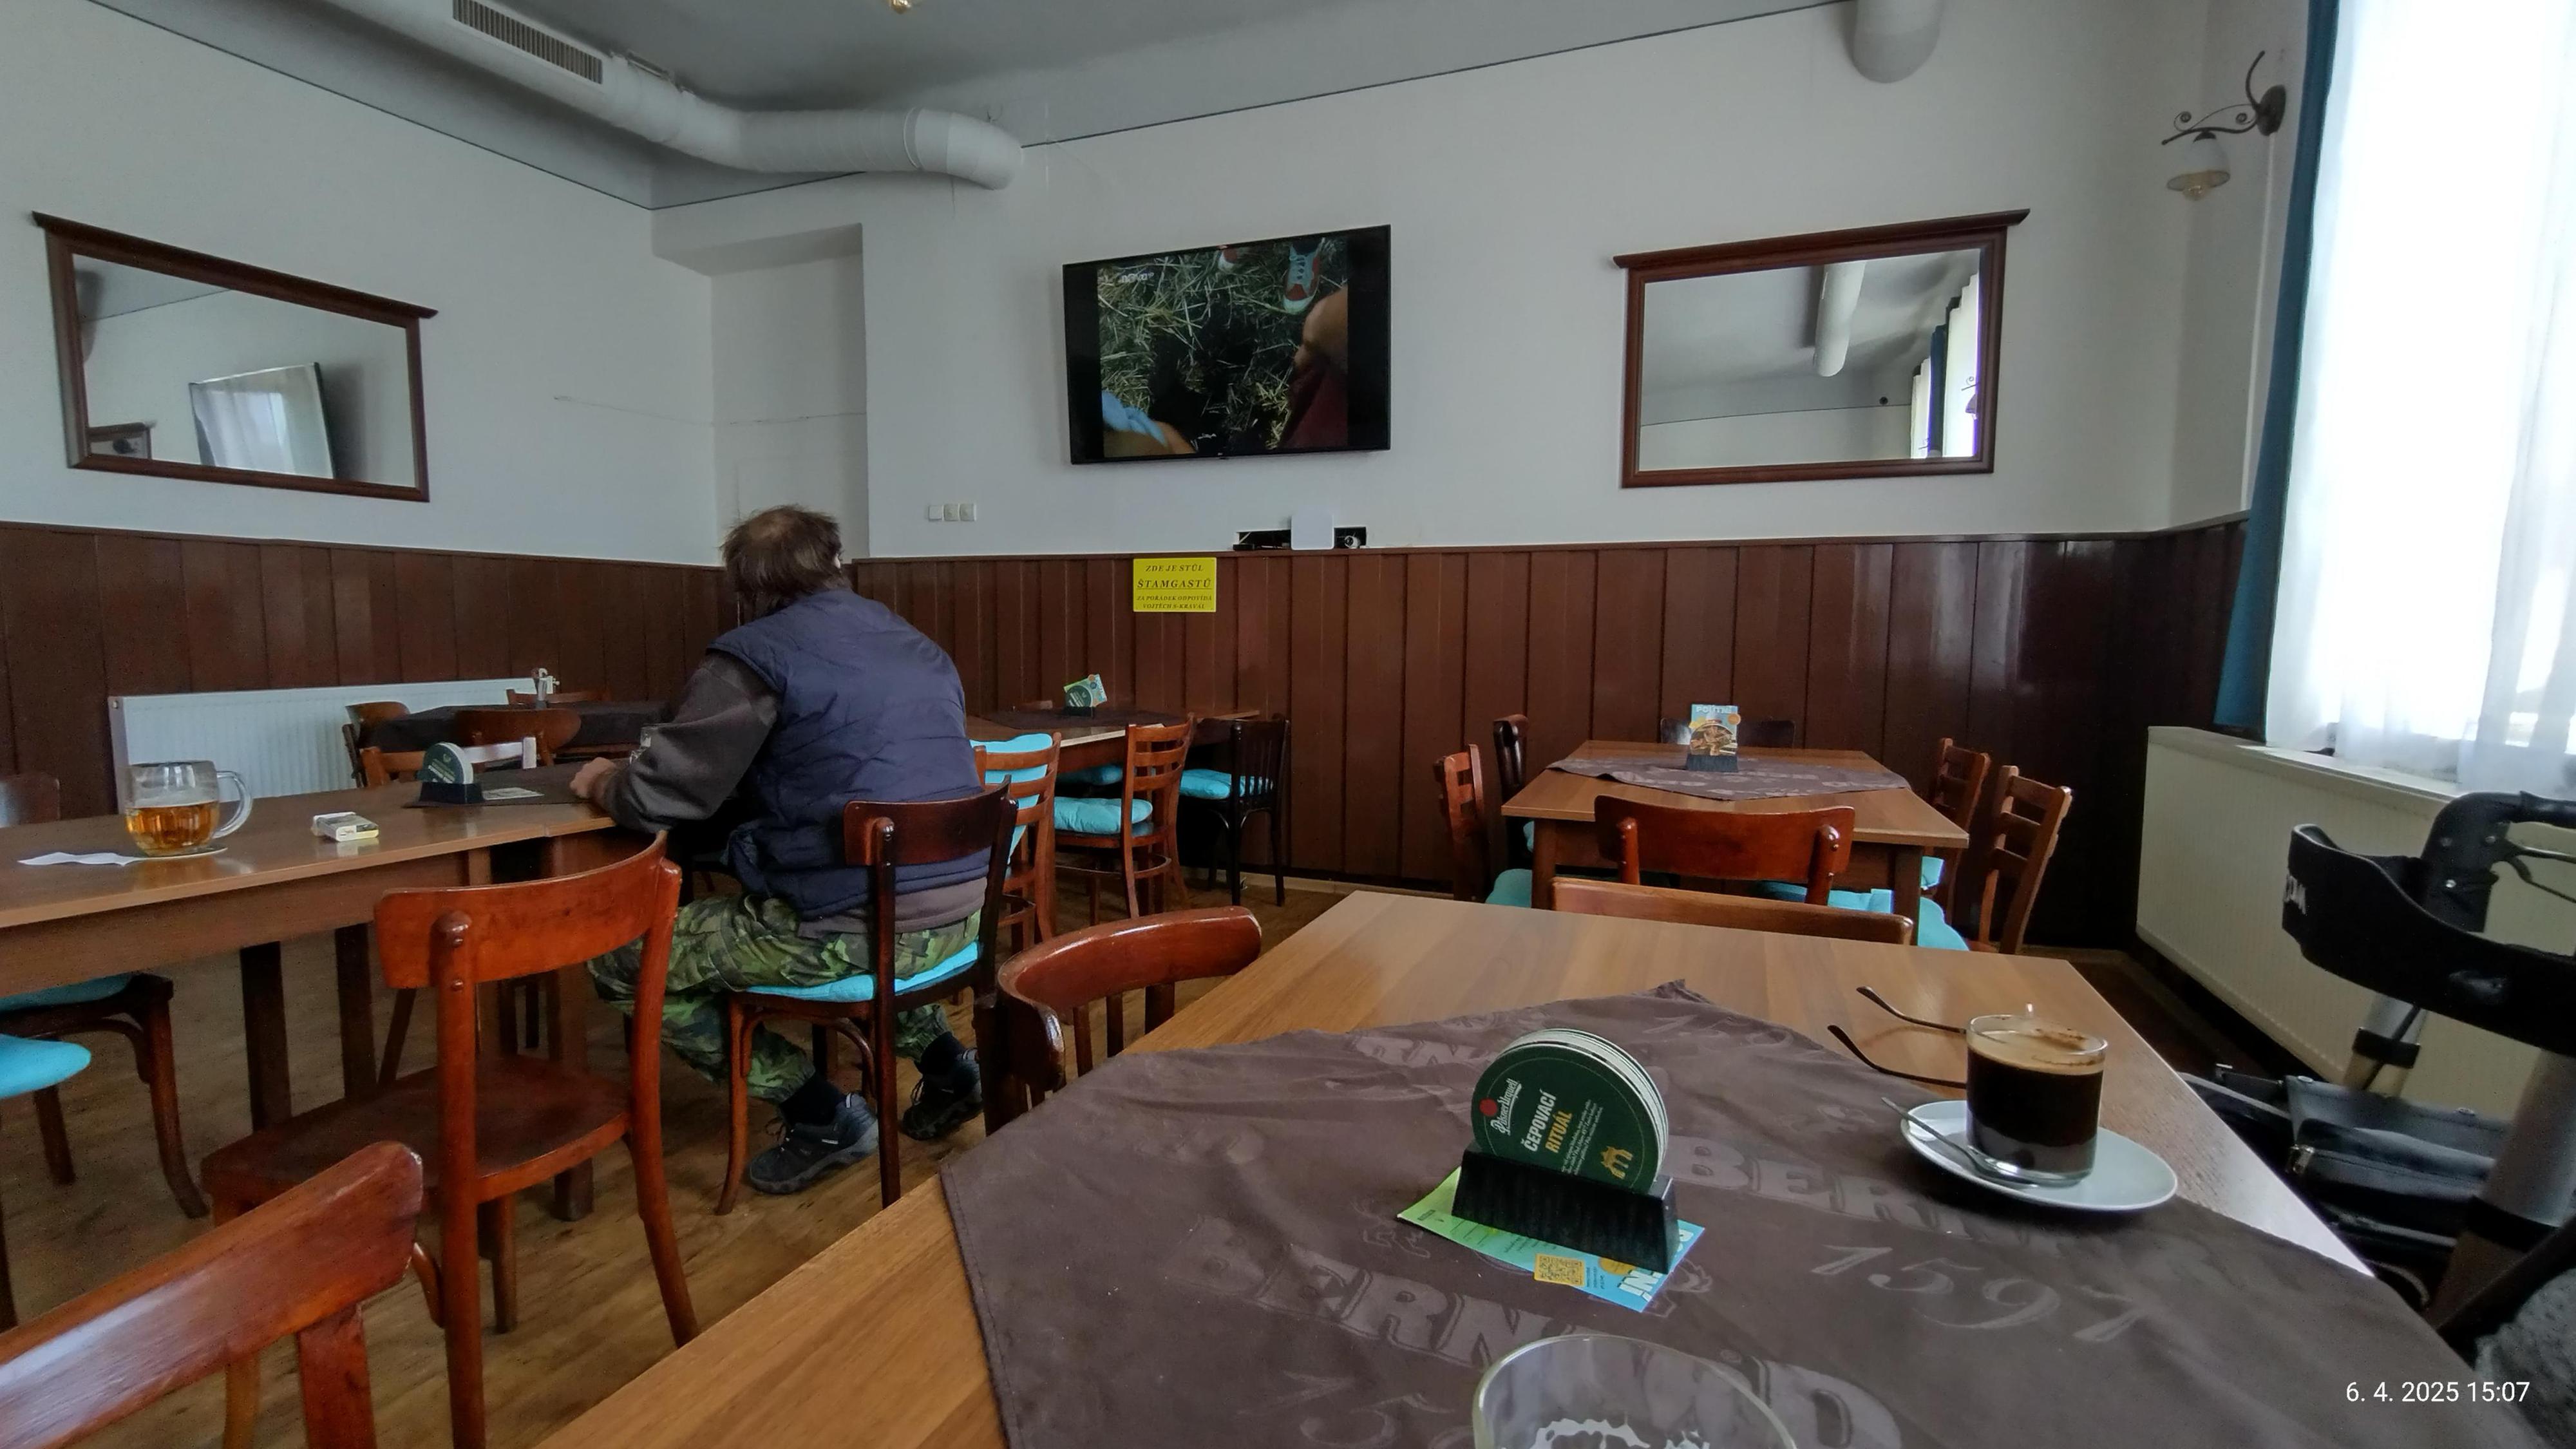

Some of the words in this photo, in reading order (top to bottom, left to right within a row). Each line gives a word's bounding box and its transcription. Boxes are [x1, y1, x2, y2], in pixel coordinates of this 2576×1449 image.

[1179, 564, 1204, 572] STŮL
[1137, 578, 1211, 588] ŠTAMGASTŮ
[1520, 1088, 1557, 1151] ČEPOVACÍ
[1546, 1111, 1573, 1153] RITUÁL
